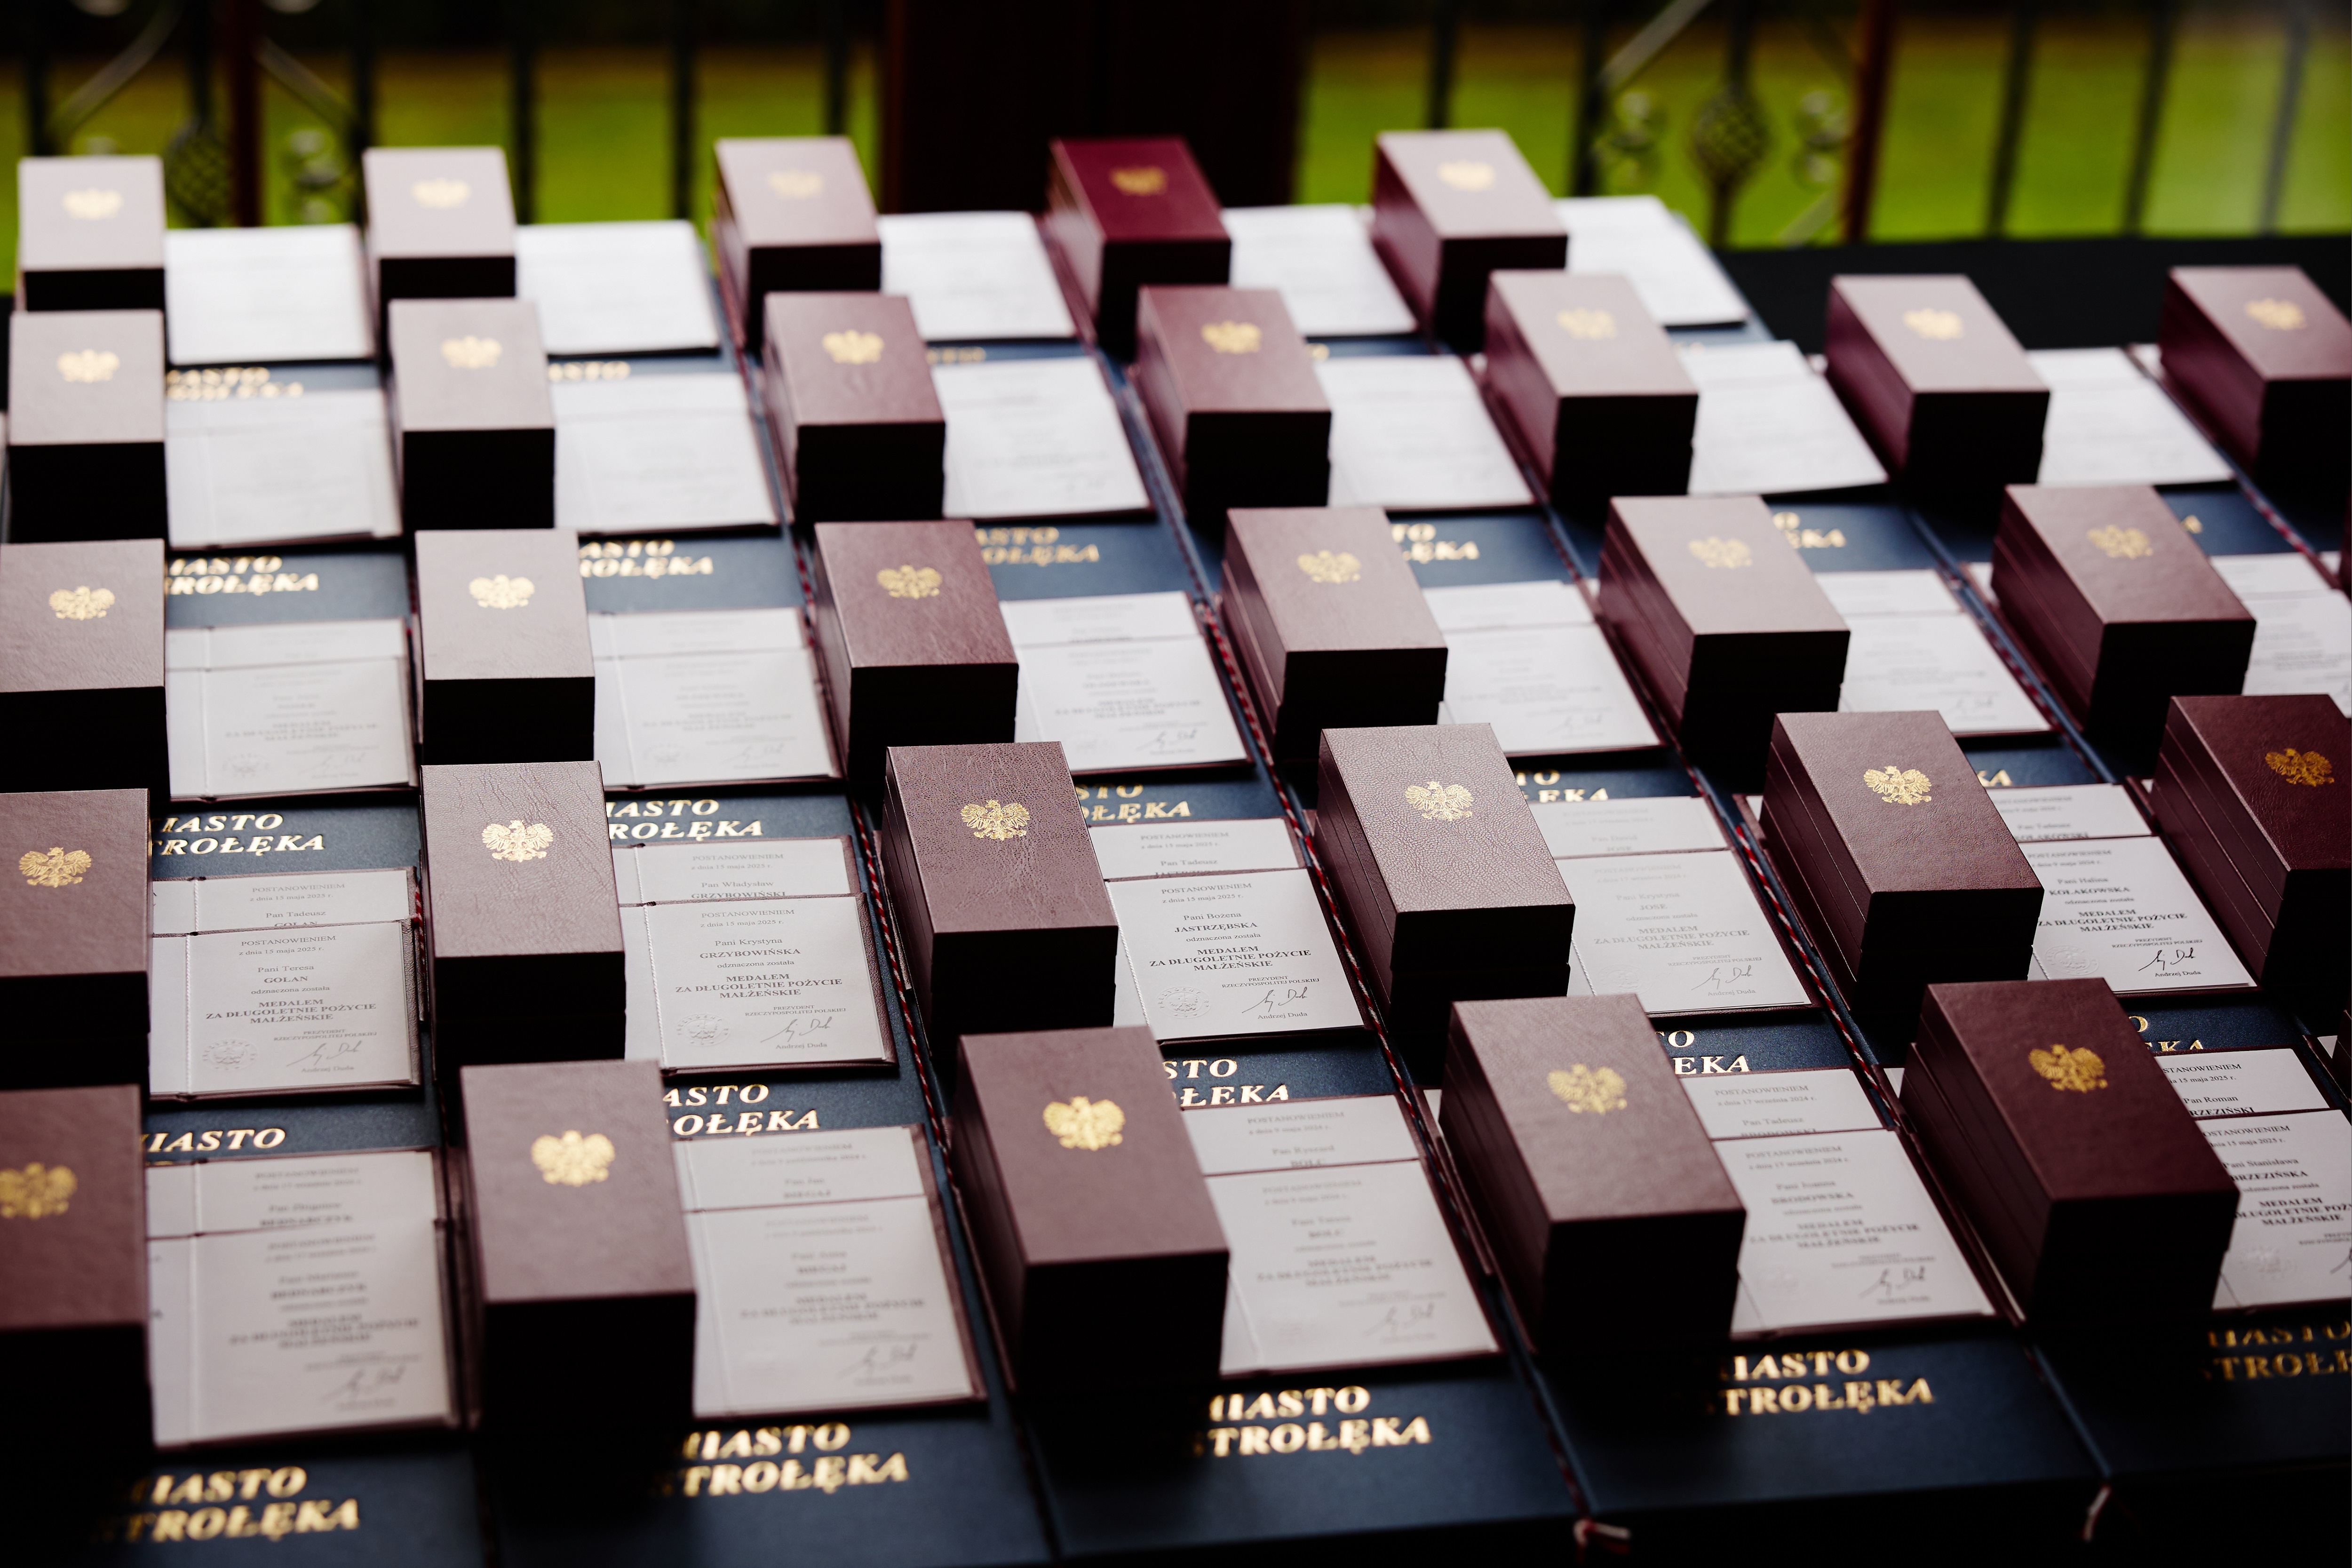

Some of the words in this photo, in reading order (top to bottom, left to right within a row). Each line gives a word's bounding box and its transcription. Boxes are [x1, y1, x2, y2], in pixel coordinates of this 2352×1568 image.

[170, 555, 282, 575] IASTO
[169, 573, 319, 596] ROŁĘKA
[606, 799, 720, 818] IASTO
[160, 814, 283, 833] IASTO
[609, 820, 763, 842] ROŁĘKA
[158, 835, 325, 856] ROŁĘKA
[1162, 883, 1251, 894] POSTANOWIENIEM
[2055, 915, 2136, 926] DŁUGOLETNIE
[2138, 913, 2187, 922] POŻYCIE
[2078, 909, 2137, 917] MEDALEM
[1175, 923, 1257, 932] JASTRZĘBSKA
[1638, 926, 1698, 934] MEDALEM
[2080, 923, 2154, 932] MAŁŻEŃSKIE
[242, 936, 335, 946] POSTANOWIENIEM
[1613, 933, 1696, 944] DŁUGOLETNIE
[1699, 930, 1749, 939] POŻYCIE
[1197, 946, 1259, 955] MEDALEM
[1638, 940, 1714, 950] MAŁŻEŃSKIE
[700, 948, 801, 958] GRZYBOWIŃSKA
[1169, 954, 1255, 965] DŁUGOLETNIE
[1259, 950, 1311, 959] POŻYCIE
[1194, 961, 1273, 971] MAŁŻEŃSKIE
[696, 981, 785, 992] DŁUGOLETNIE
[788, 978, 842, 987] POŻYCIE
[720, 989, 801, 998] MAŁŻEŃSKIE
[259, 999, 324, 1008] MEDALEM
[226, 1007, 318, 1018] DŁUGOLETNIE
[321, 1004, 376, 1013] POŻYCIE
[250, 1014, 333, 1023] MAŁŻEŃSKIE
[1162, 1059, 1238, 1079] STO
[2163, 1064, 2242, 1074] STANOWIENIEM
[662, 1084, 769, 1106] ASTO
[1715, 1085, 1809, 1095] POSTANOWIENIEM
[2189, 1107, 2255, 1116] RZEZIŃSKI
[673, 1109, 820, 1137] OŁĘKA
[2203, 1125, 2290, 1136] OSTANOWIENIEM
[148, 1128, 286, 1152] IASTO
[1733, 1349, 1870, 1381] IASTO
[1719, 1377, 1934, 1415] TROŁĘKA
[1208, 1416, 1432, 1457] TROŁĘKA
[677, 1452, 909, 1497] TROŁĘKA
[151, 1466, 307, 1504] IASTO
[125, 1498, 360, 1543] TROŁĘKA
